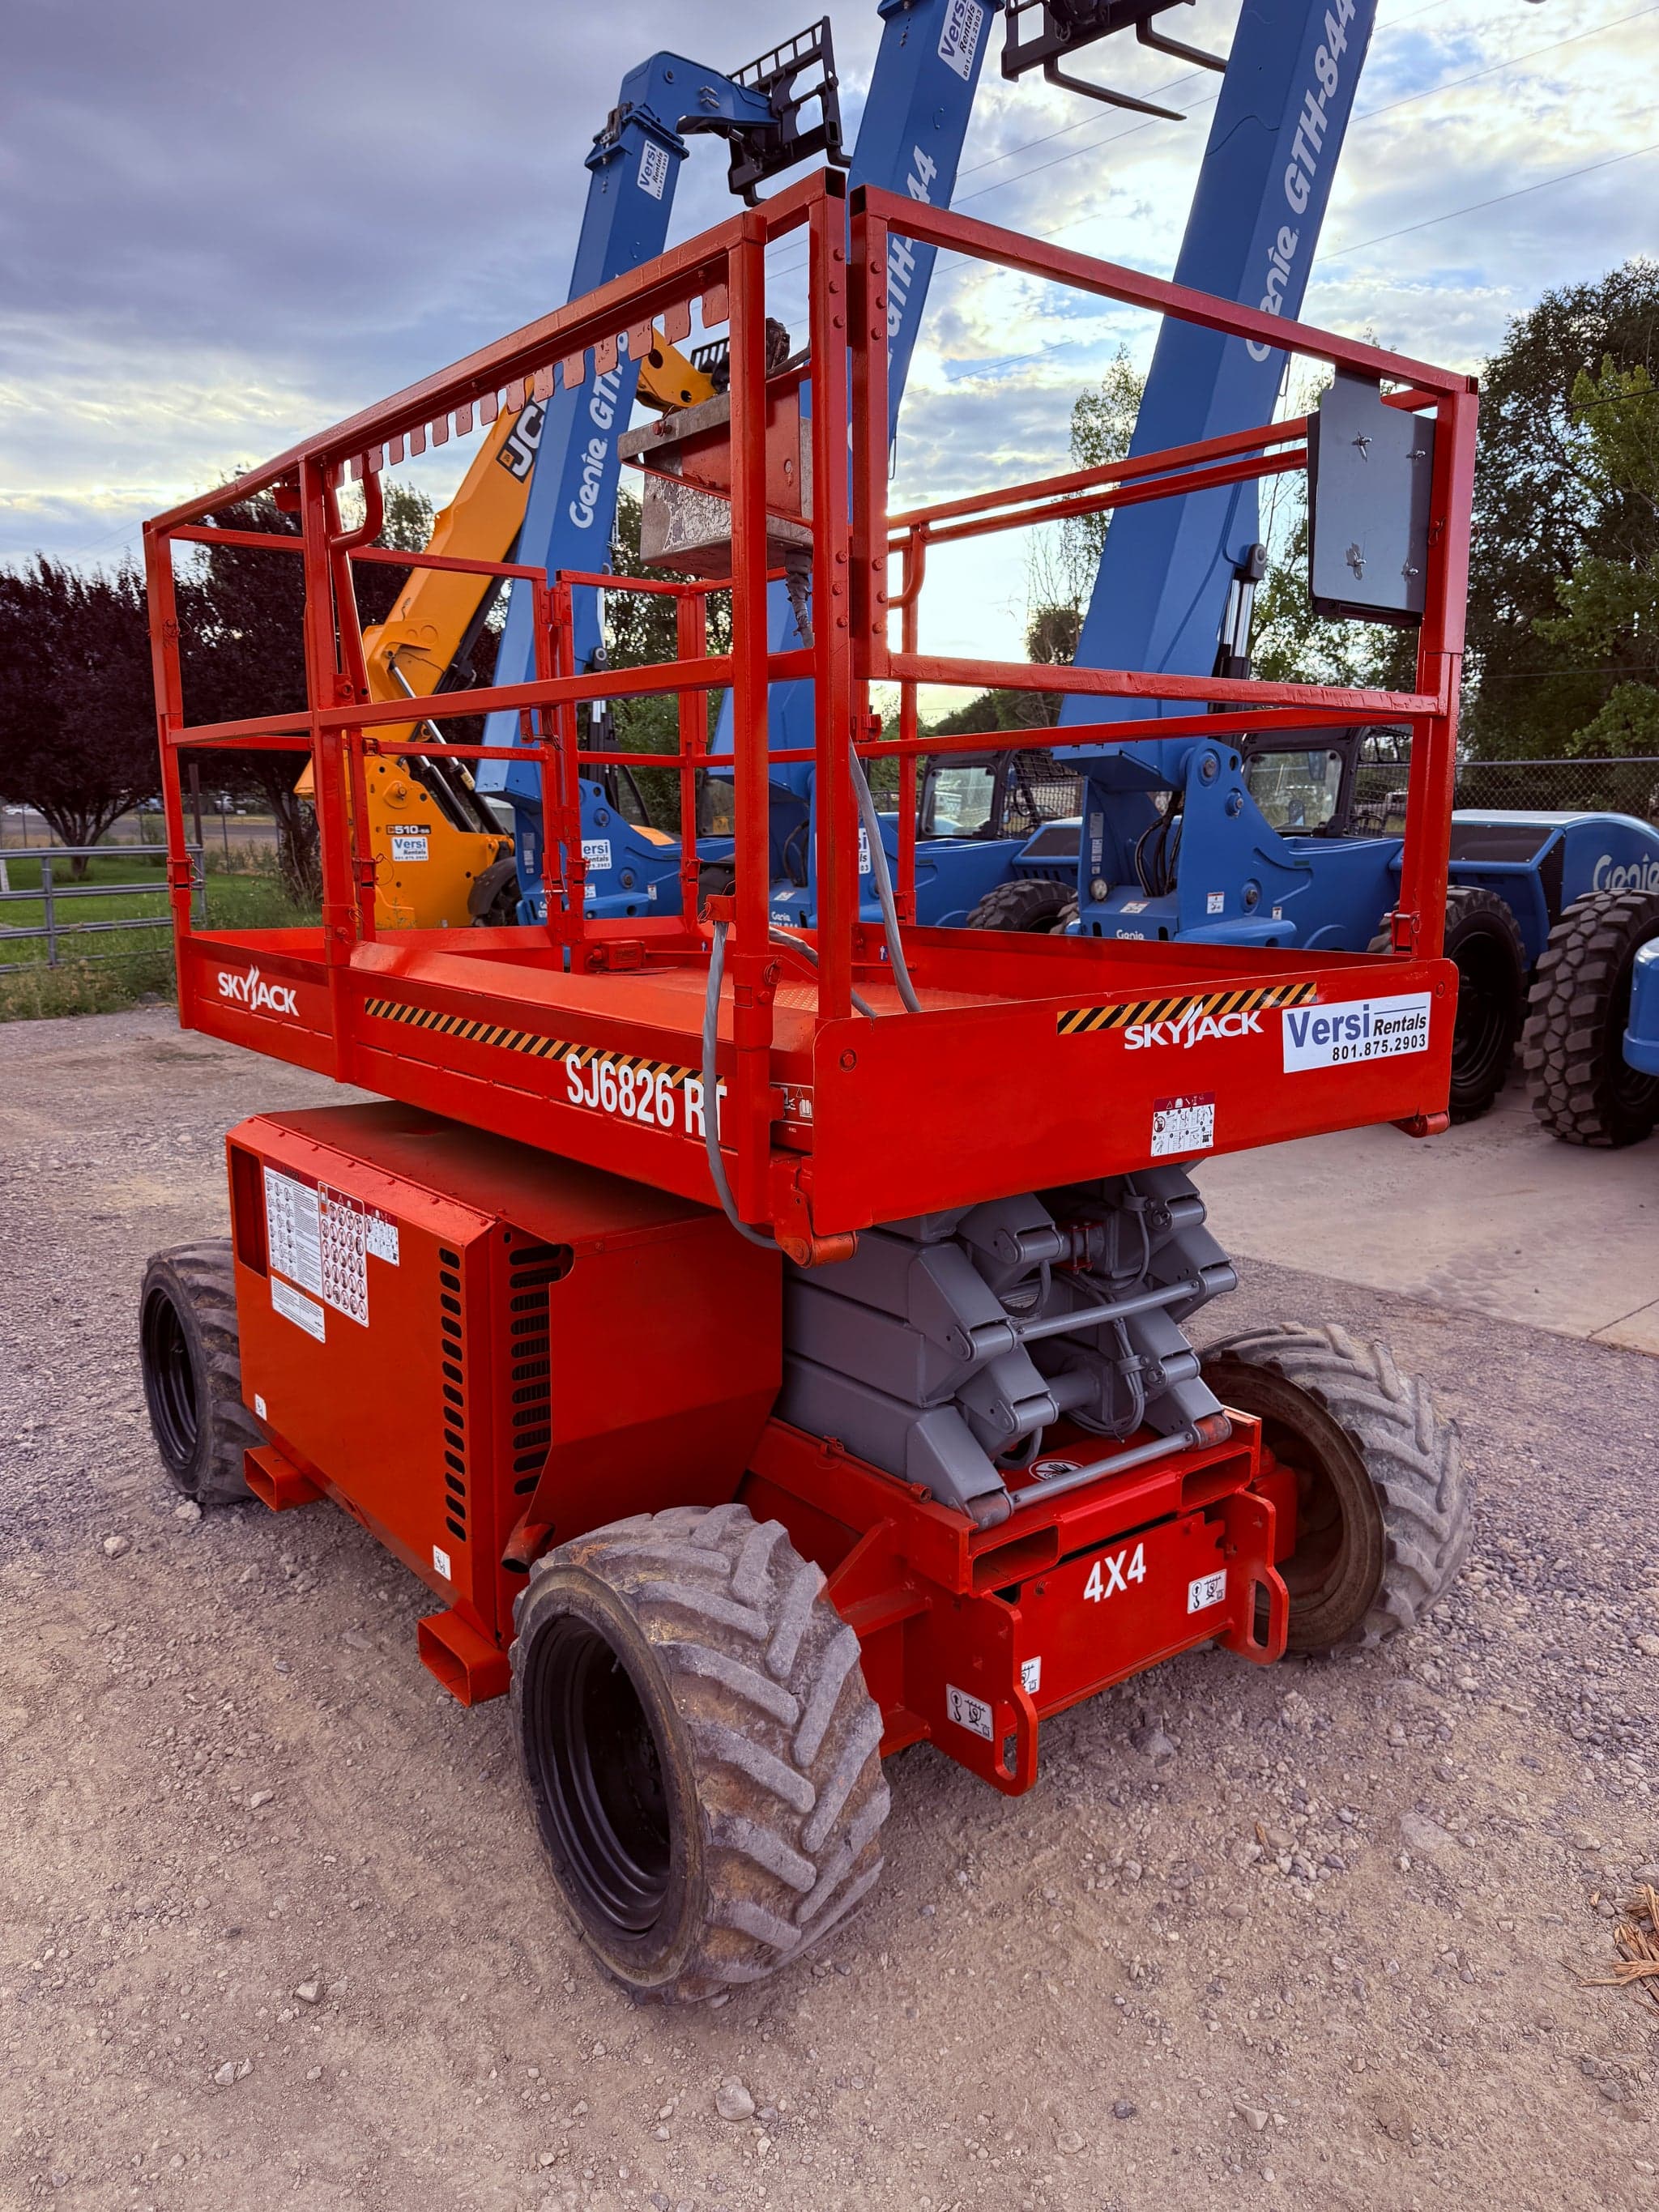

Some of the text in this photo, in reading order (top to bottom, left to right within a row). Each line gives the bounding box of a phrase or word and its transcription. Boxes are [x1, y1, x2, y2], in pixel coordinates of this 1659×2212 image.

[940, 0, 968, 57] Vers
[959, 5, 975, 53] Rentals
[963, 9, 982, 77] 801.875.2903
[639, 143, 657, 186] Versi
[653, 151, 663, 183] Rentals
[504, 395, 548, 476] JC
[569, 437, 608, 529] Genie
[394, 838, 426, 849] Versi
[583, 842, 608, 855] ersi
[218, 964, 300, 1016] SKYJACK
[1124, 1001, 1264, 1050] SKYJACK
[1286, 1004, 1427, 1048] Versi Rentals
[1332, 1034, 1426, 1062] 801.875.2903
[566, 1054, 675, 1127] SJ6826
[1083, 1542, 1146, 1603] 4X4
